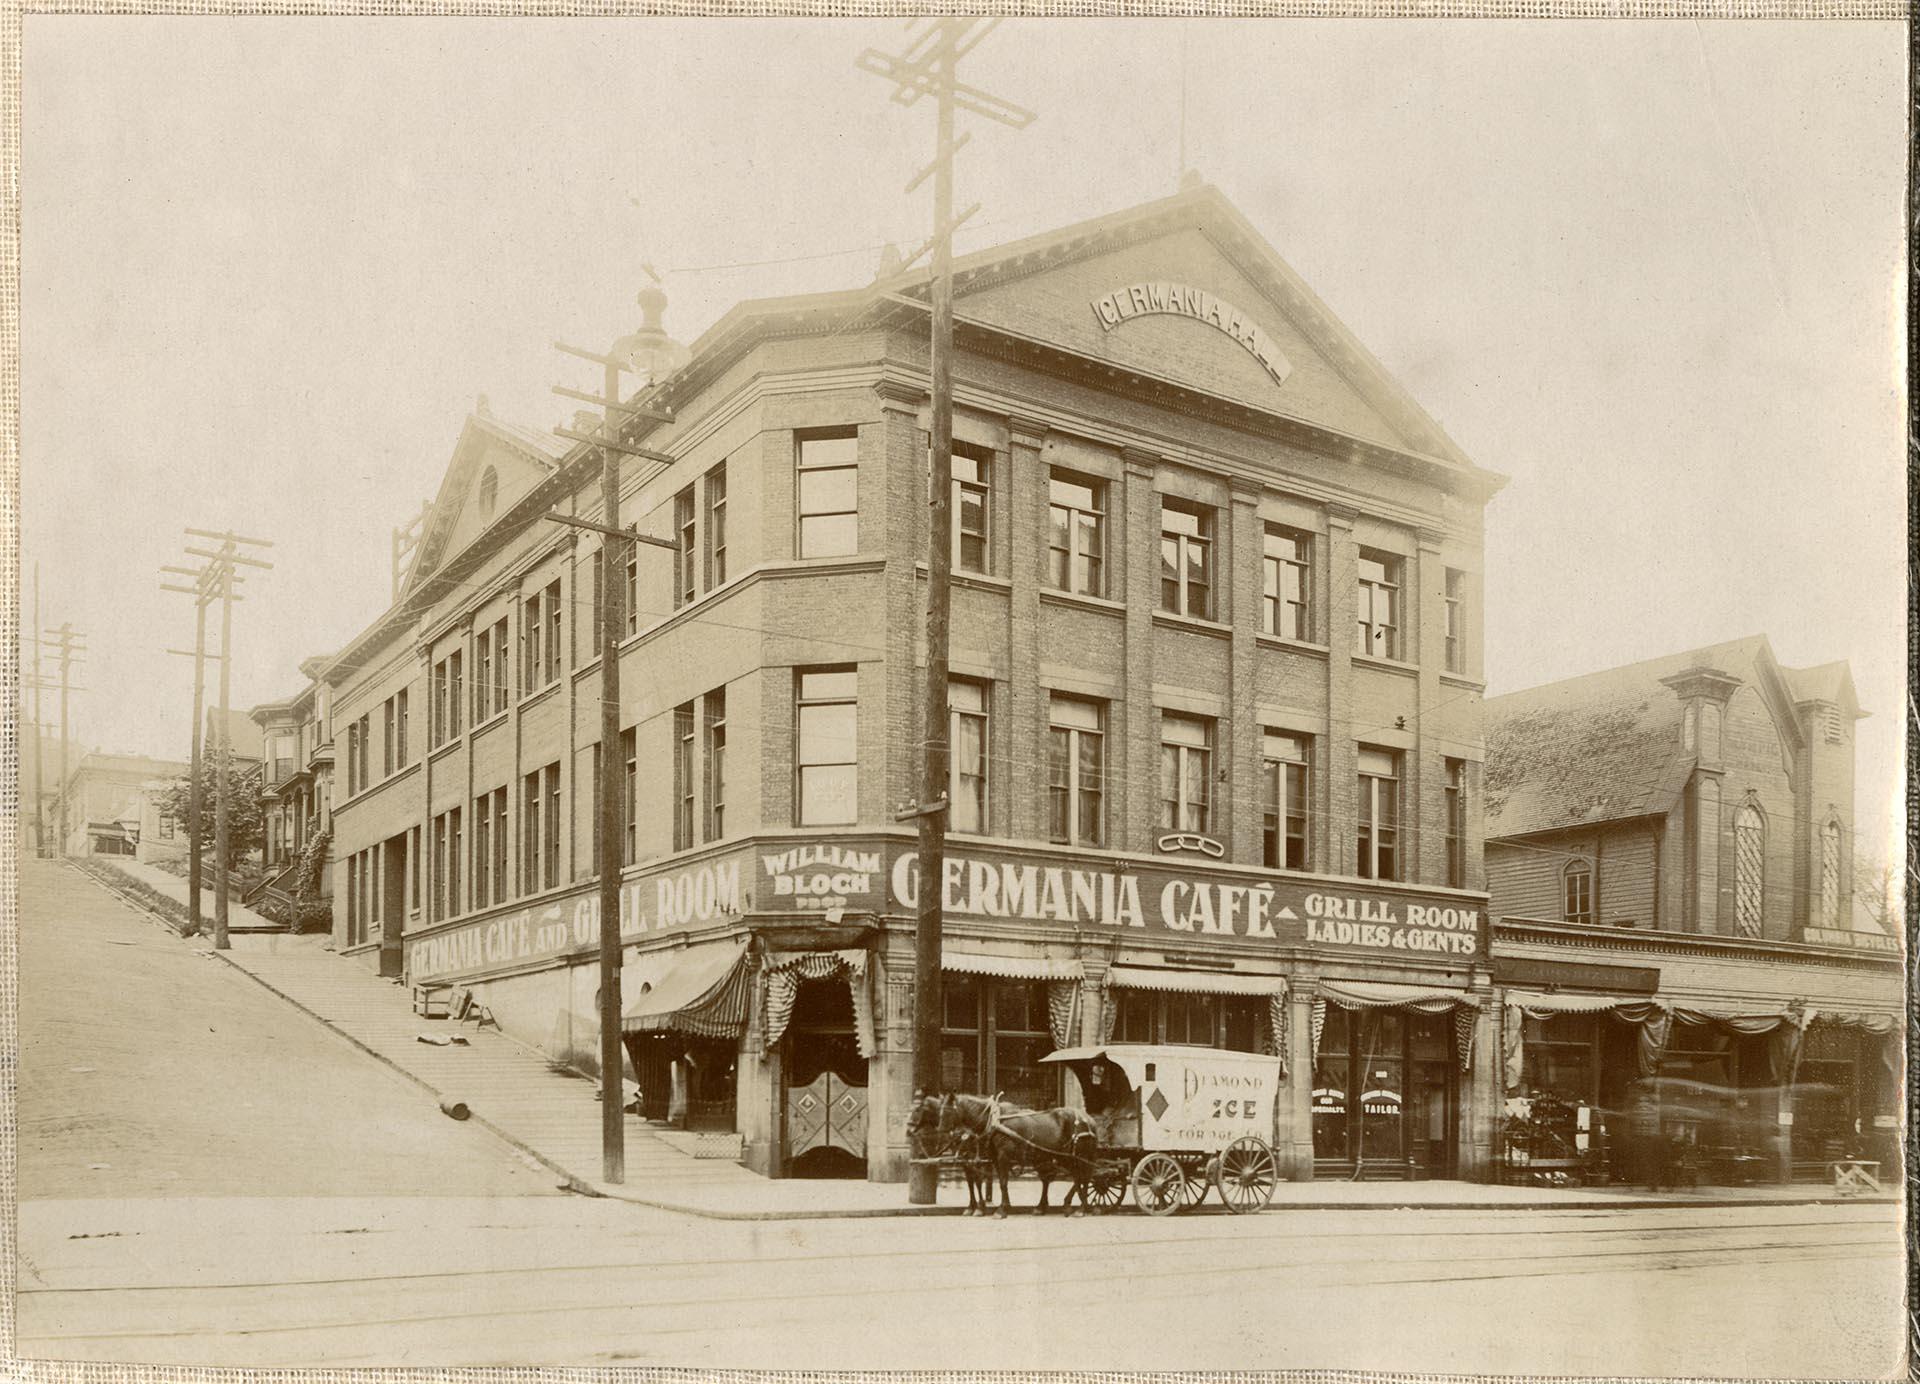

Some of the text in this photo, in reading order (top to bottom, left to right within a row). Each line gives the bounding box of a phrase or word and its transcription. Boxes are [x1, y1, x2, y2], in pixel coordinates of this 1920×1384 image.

[1100, 282, 1222, 327] GERMANIA
[761, 844, 881, 876] WILLIAM
[773, 872, 871, 895] BLOCH
[891, 851, 1145, 927] GERMANIA
[410, 859, 742, 981] GERMANIA CAFÉ AND GRLL ROOM
[1304, 892, 1478, 932] GRILL ROOM
[1305, 919, 1477, 955] LADIES & GENTS
[1183, 1067, 1263, 1100] DIAMOND
[1212, 1099, 1256, 1119] ICE
